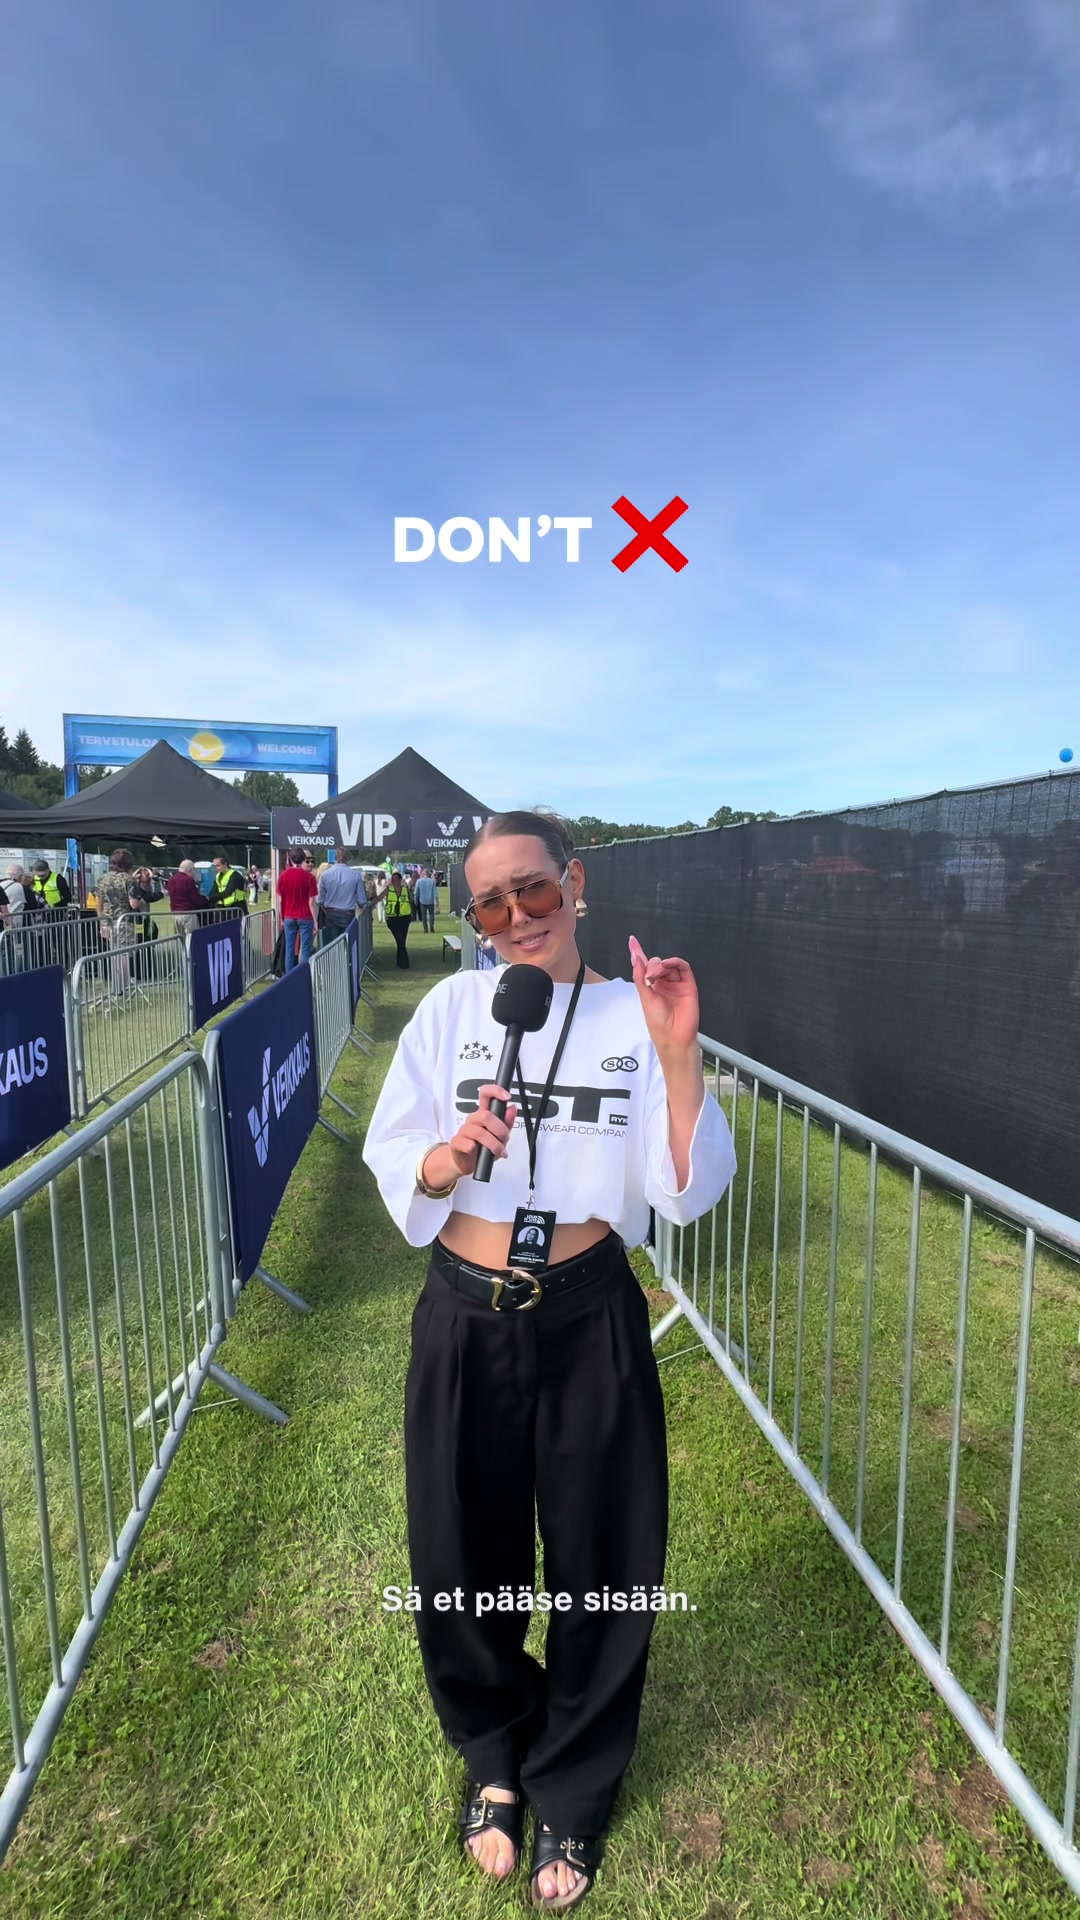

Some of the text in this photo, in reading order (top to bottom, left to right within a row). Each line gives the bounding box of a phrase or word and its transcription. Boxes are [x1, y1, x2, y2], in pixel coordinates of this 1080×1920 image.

[257, 743, 316, 755] WELCOME!
[287, 836, 335, 846] VEIKKAUS
[336, 813, 397, 847] VIP
[207, 937, 233, 1005] VIP
[271, 1031, 310, 1120] VEIKKAUS
